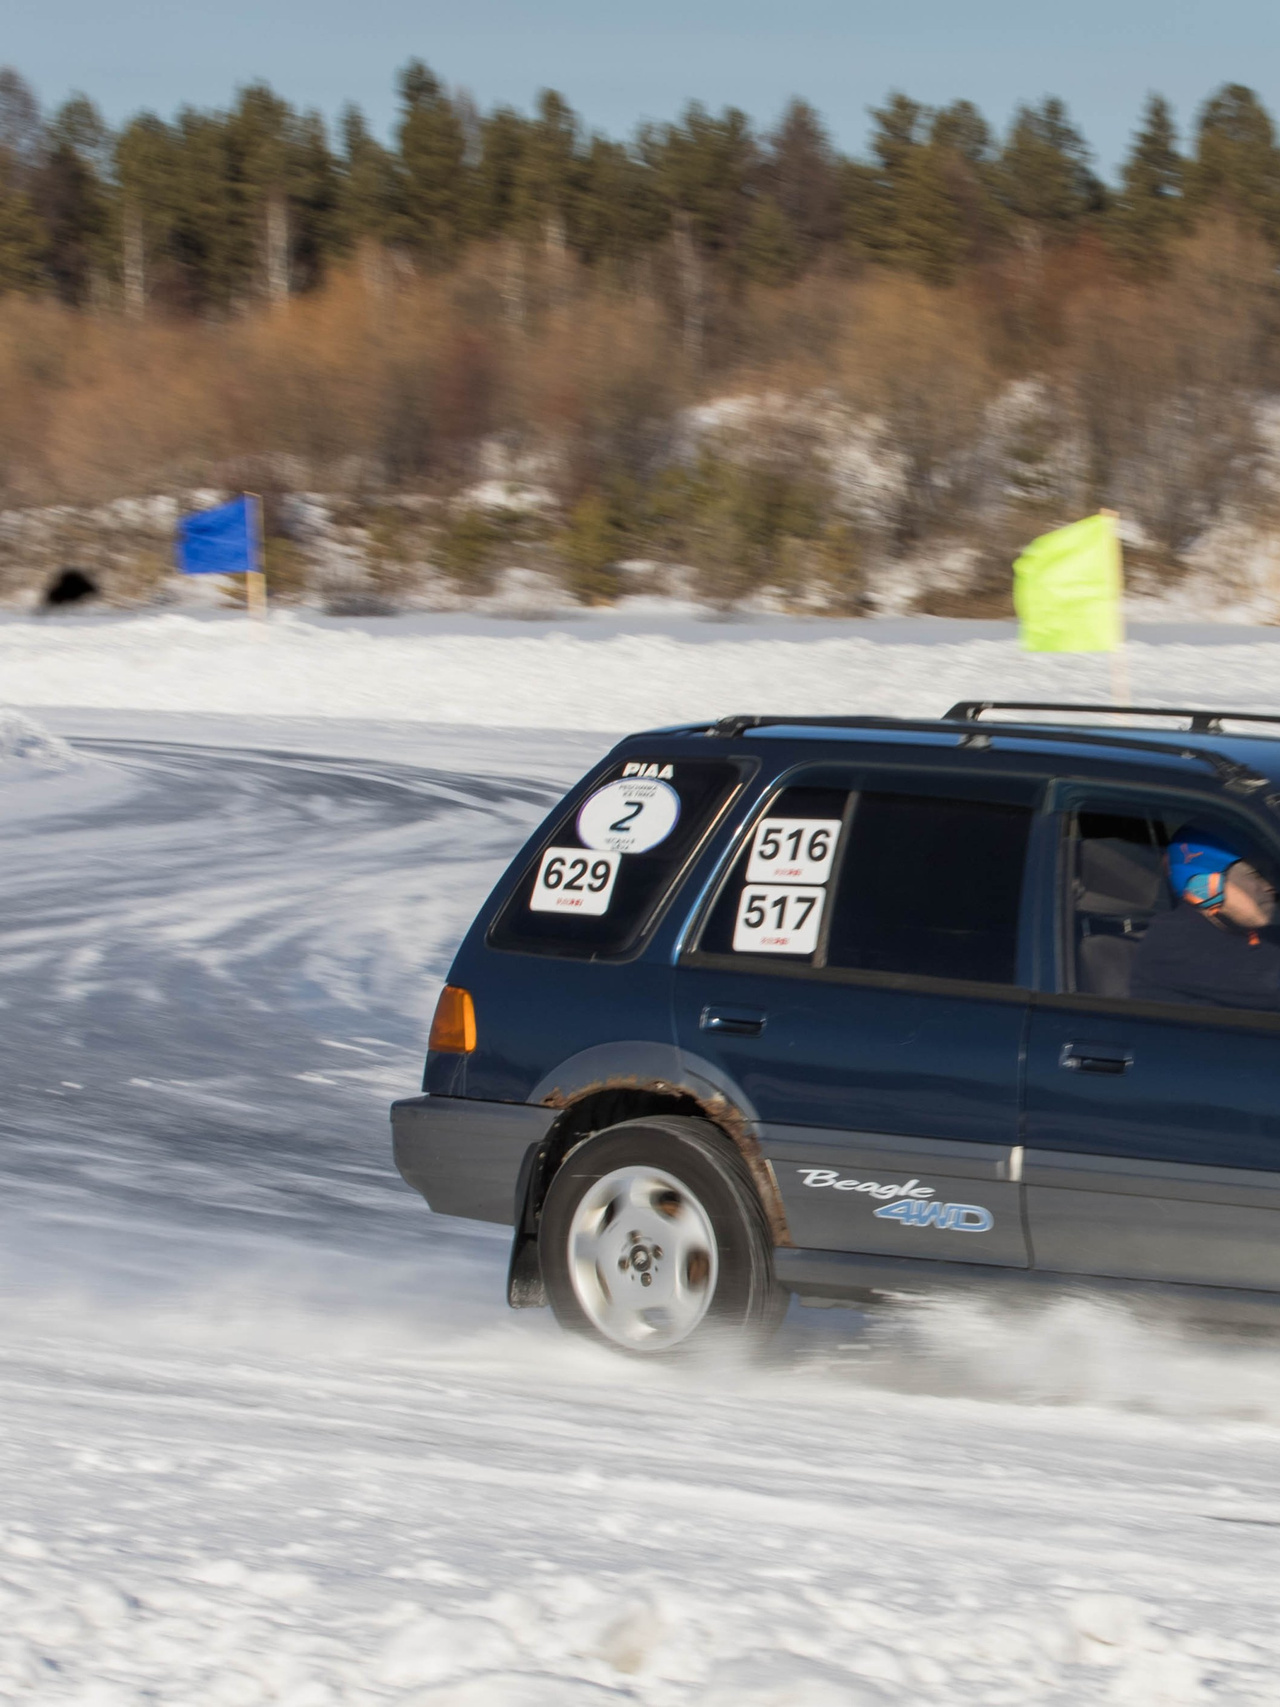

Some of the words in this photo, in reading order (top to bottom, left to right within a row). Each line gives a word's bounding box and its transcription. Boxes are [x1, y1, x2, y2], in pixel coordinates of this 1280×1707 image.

[622, 762, 674, 779] PIAA
[609, 801, 643, 831] 2
[759, 828, 831, 861] 516
[544, 857, 611, 892] 629
[745, 895, 818, 930] 517
[796, 1169, 935, 1200] Beagle
[873, 1199, 994, 1232] 4WD
